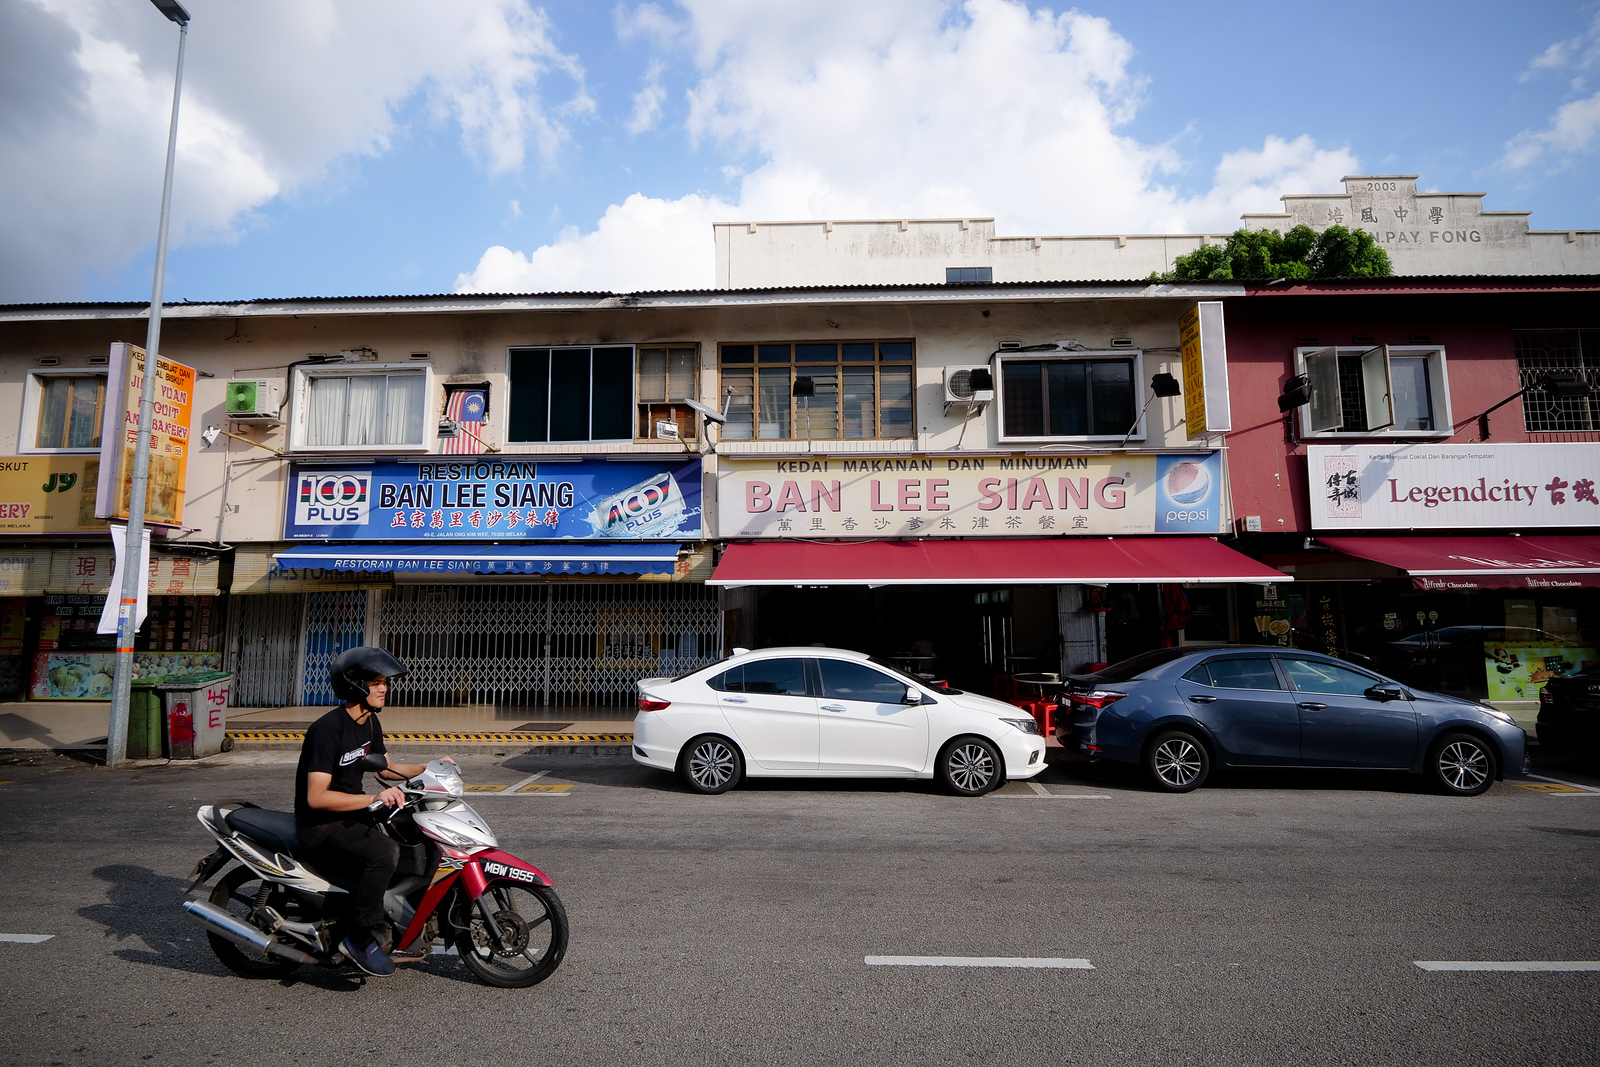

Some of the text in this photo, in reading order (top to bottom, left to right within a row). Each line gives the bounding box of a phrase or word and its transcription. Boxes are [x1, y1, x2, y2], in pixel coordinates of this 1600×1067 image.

[1367, 182, 1396, 191] 2003
[1327, 206, 1444, 225] 培風中學
[1430, 230, 1482, 243] FONG
[1185, 341, 1198, 361] BAN
[156, 358, 178, 375] EMBUAT
[179, 368, 191, 380] DAN
[1186, 358, 1199, 378] LEE
[165, 372, 185, 387] BISKUT
[161, 384, 187, 405] YUAN
[125, 410, 188, 440] AN BAKERY
[419, 463, 537, 481] RESTORAN
[777, 457, 1089, 473] KEDAI MAKANAN DAN MINUMAN
[42, 472, 78, 493] JY
[307, 475, 362, 507] 100
[1387, 477, 1539, 507] Legendcity
[379, 482, 574, 509] BAN LEE SIANG
[745, 477, 1126, 513] BAN LEE SIANG
[307, 507, 359, 521] PLUS
[626, 509, 662, 531] PLUS
[1165, 508, 1209, 523] pepsi
[334, 559, 394, 569] RESTORAN
[397, 560, 420, 569] BAN
[423, 561, 444, 570] LEE
[447, 561, 481, 570] SIANG
[207, 688, 229, 706] 45
[208, 709, 222, 728] E
[484, 862, 536, 883] MBW 1955
